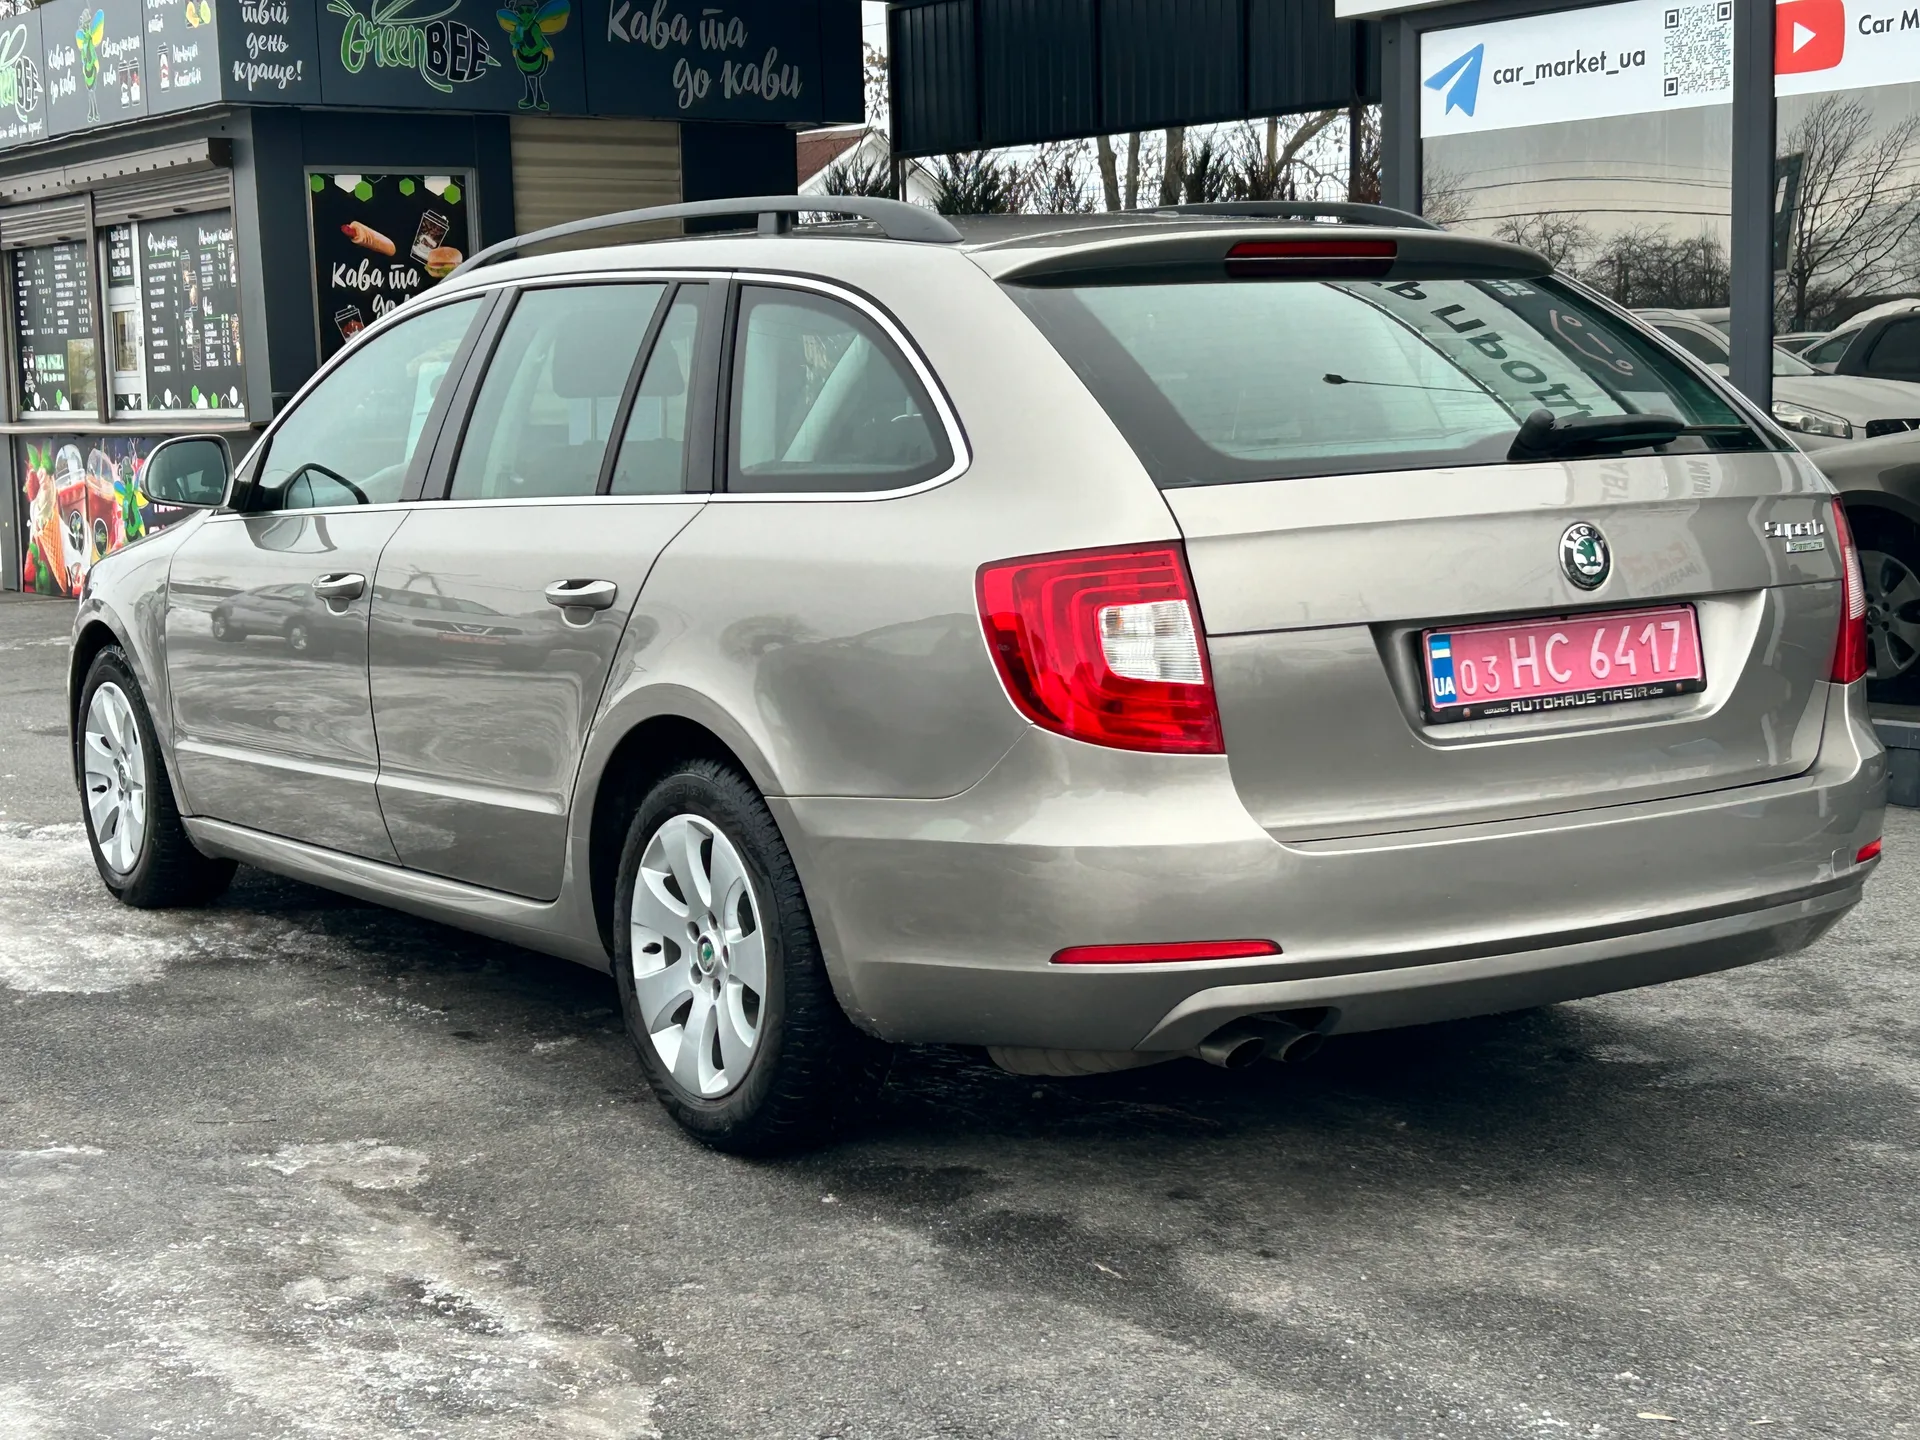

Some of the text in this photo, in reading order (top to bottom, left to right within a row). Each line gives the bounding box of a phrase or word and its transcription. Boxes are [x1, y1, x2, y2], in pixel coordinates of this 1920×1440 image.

[607, 0, 748, 51] Кава та
[1858, 14, 1895, 36] Car
[246, 32, 289, 60] день
[232, 60, 303, 92] краще!
[672, 46, 803, 110] до кави
[1493, 49, 1646, 86] car_market_ua
[331, 258, 421, 292] Кава та
[1460, 619, 1681, 696] 03 HC 6417
[1433, 676, 1456, 697] UA
